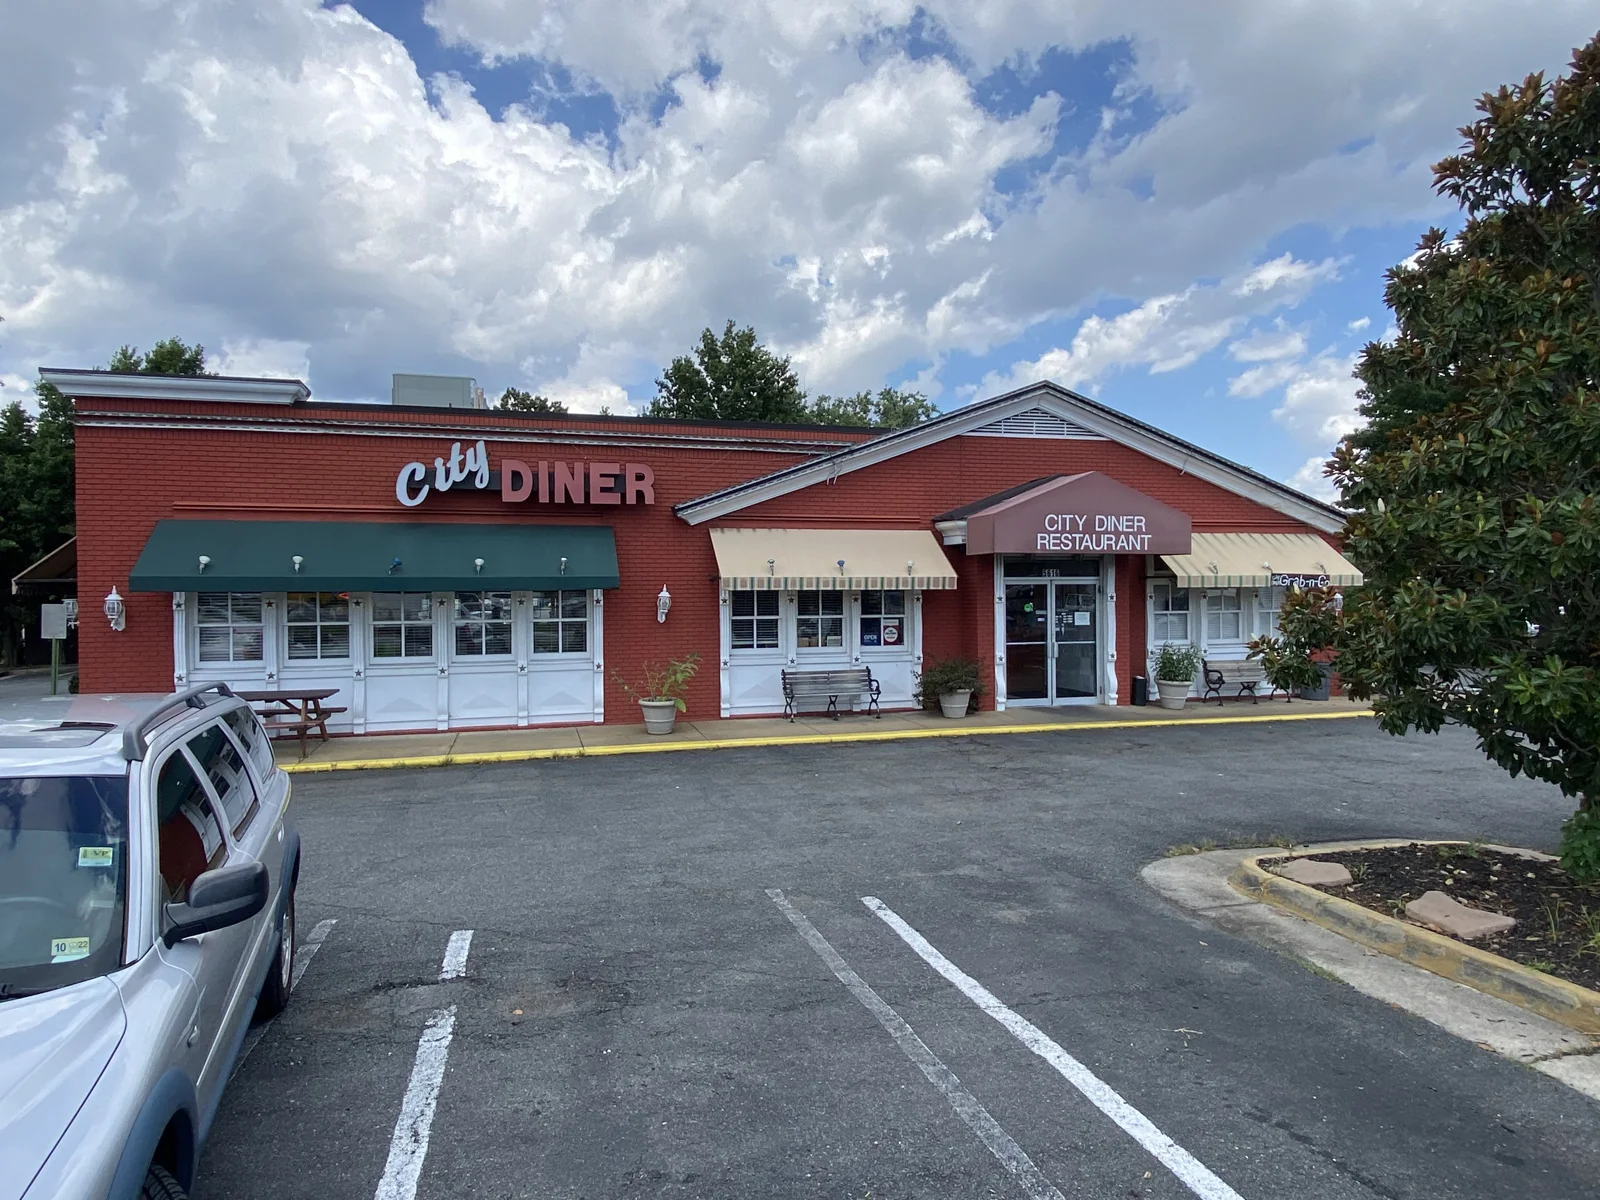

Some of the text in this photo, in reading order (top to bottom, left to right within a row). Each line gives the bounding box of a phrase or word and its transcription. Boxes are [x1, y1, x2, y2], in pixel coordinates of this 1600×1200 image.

[396, 440, 655, 507] City DINER
[1045, 514, 1146, 532] CITY DINER
[1037, 533, 1152, 550] RESTAURANT
[55, 943, 66, 952] 10
